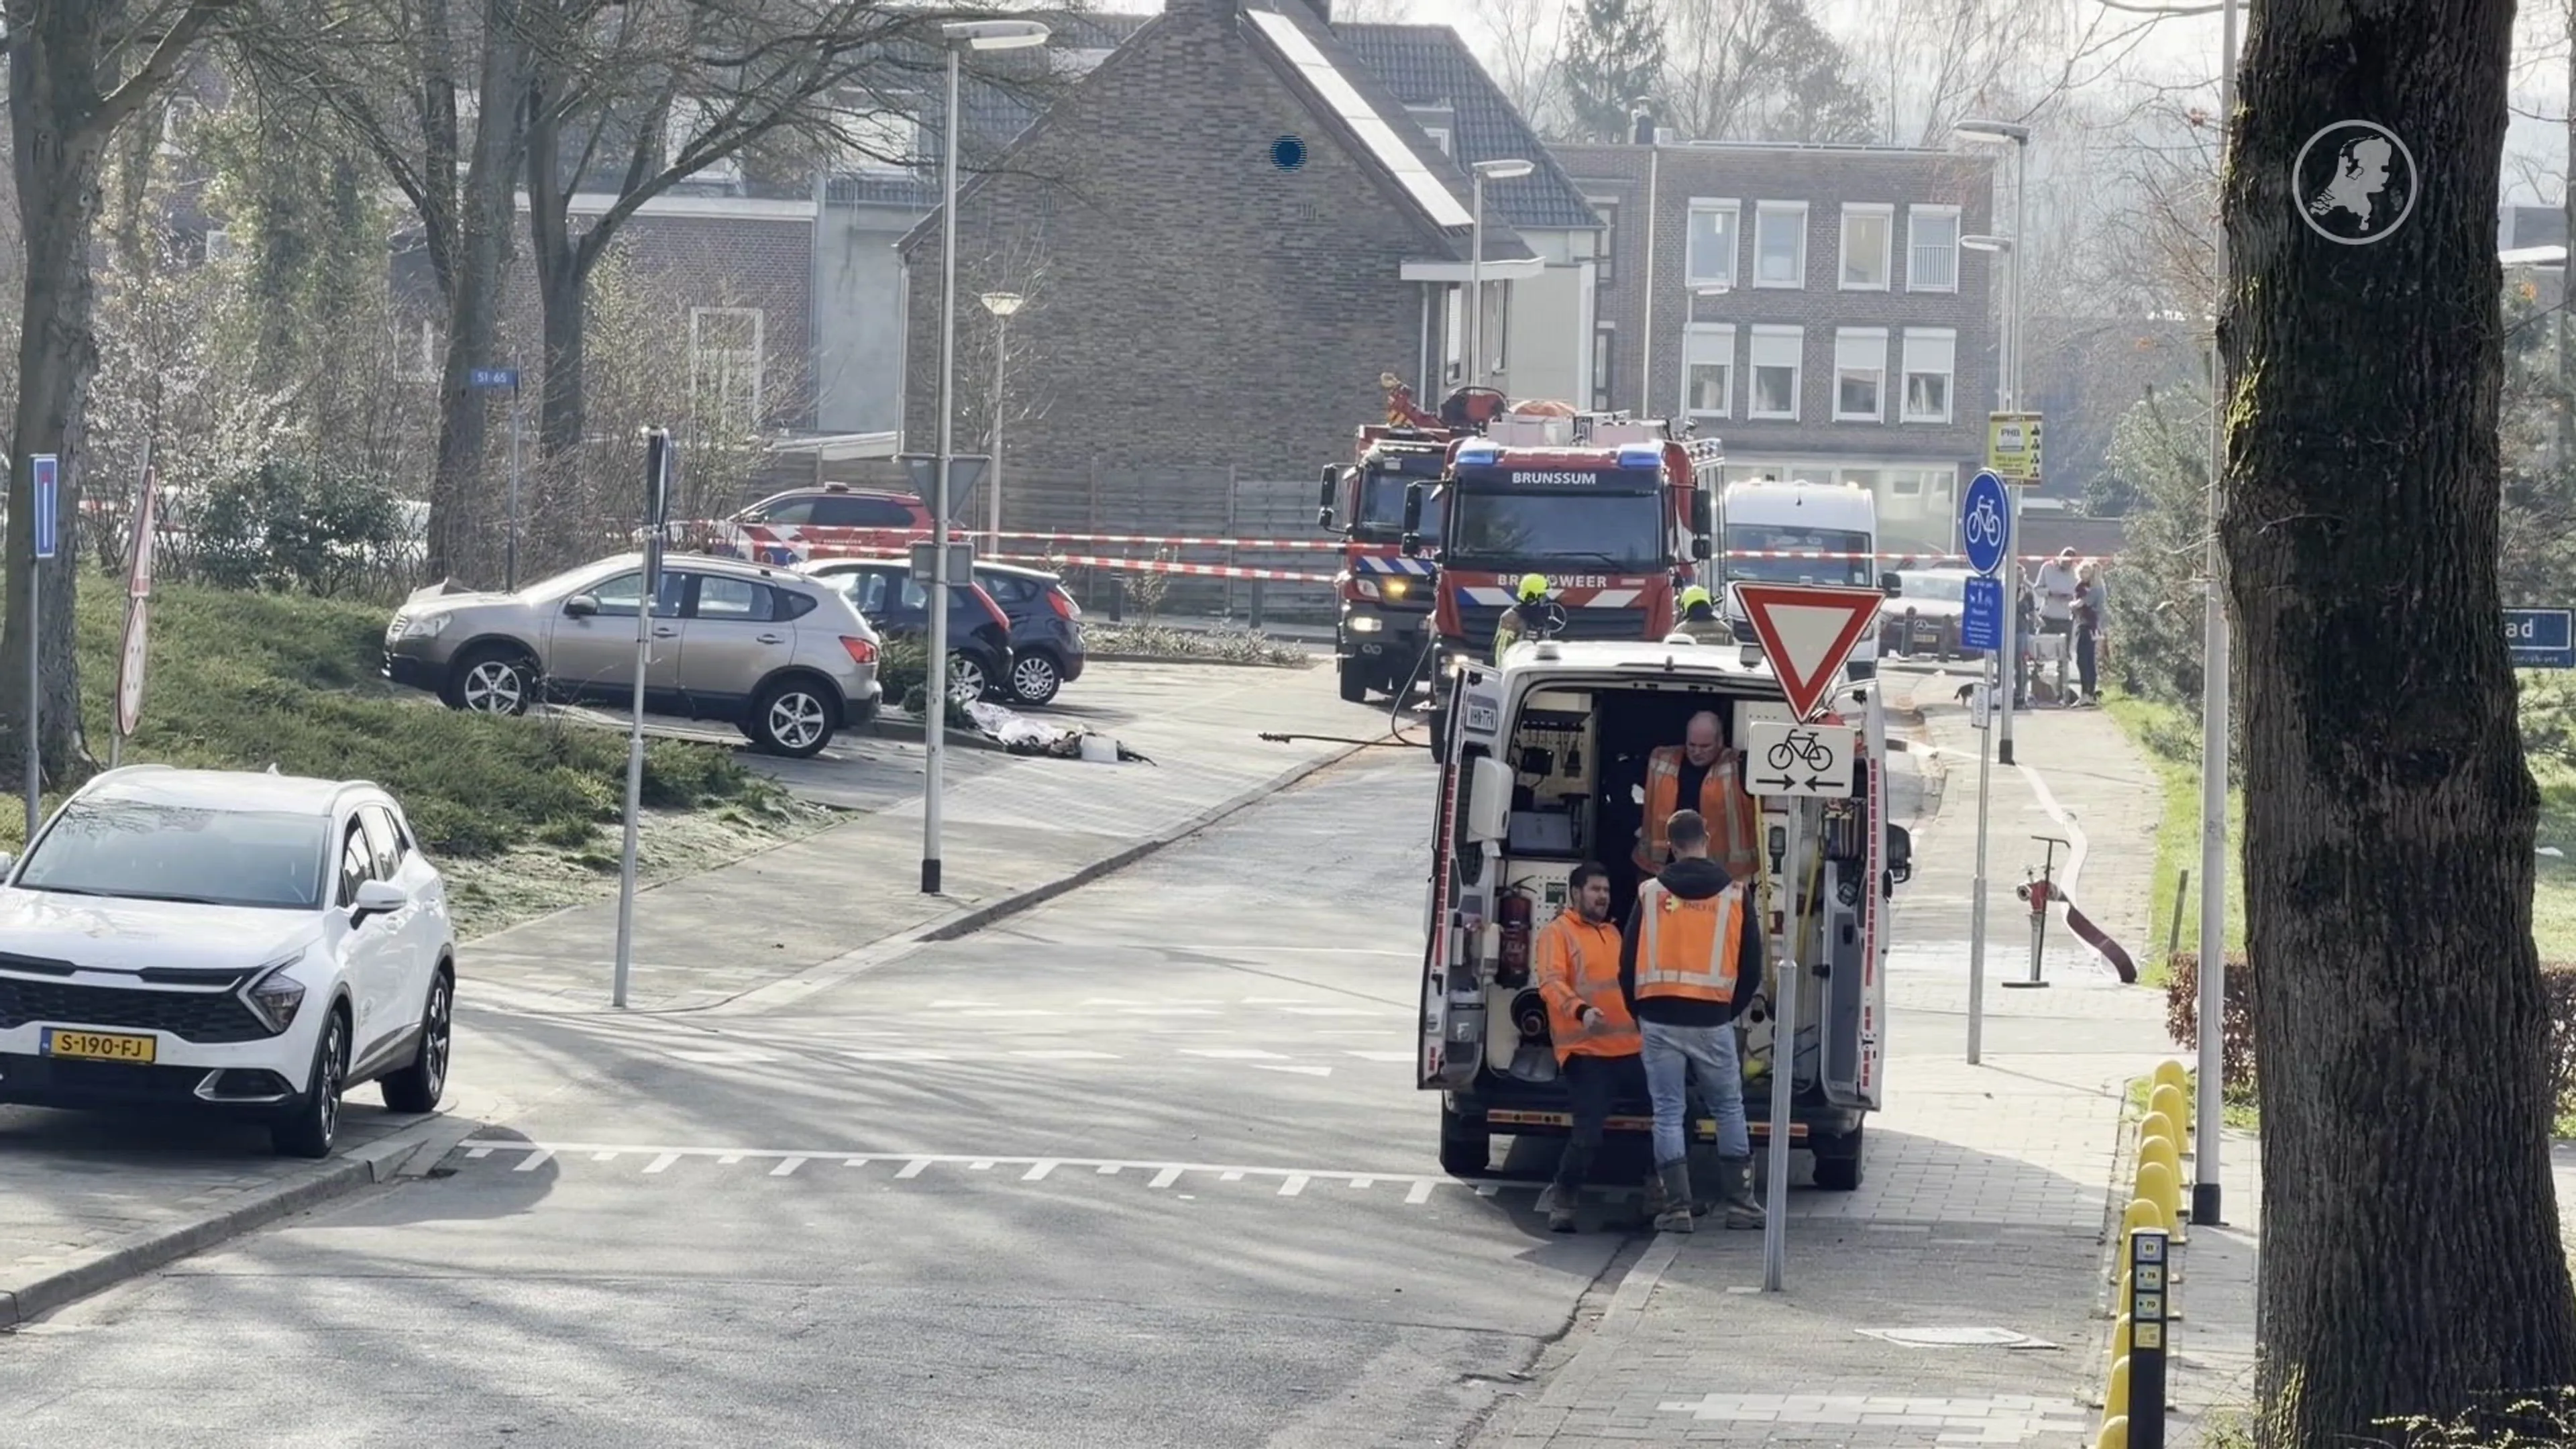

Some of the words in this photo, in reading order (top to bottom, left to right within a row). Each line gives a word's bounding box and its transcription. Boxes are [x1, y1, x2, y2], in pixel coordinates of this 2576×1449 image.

[1512, 472, 1596, 484] BRUNSSUM
[1497, 574, 1607, 588] BRDWEER
[2505, 618, 2534, 638] ad
[60, 1034, 142, 1057] S-190-FJ
